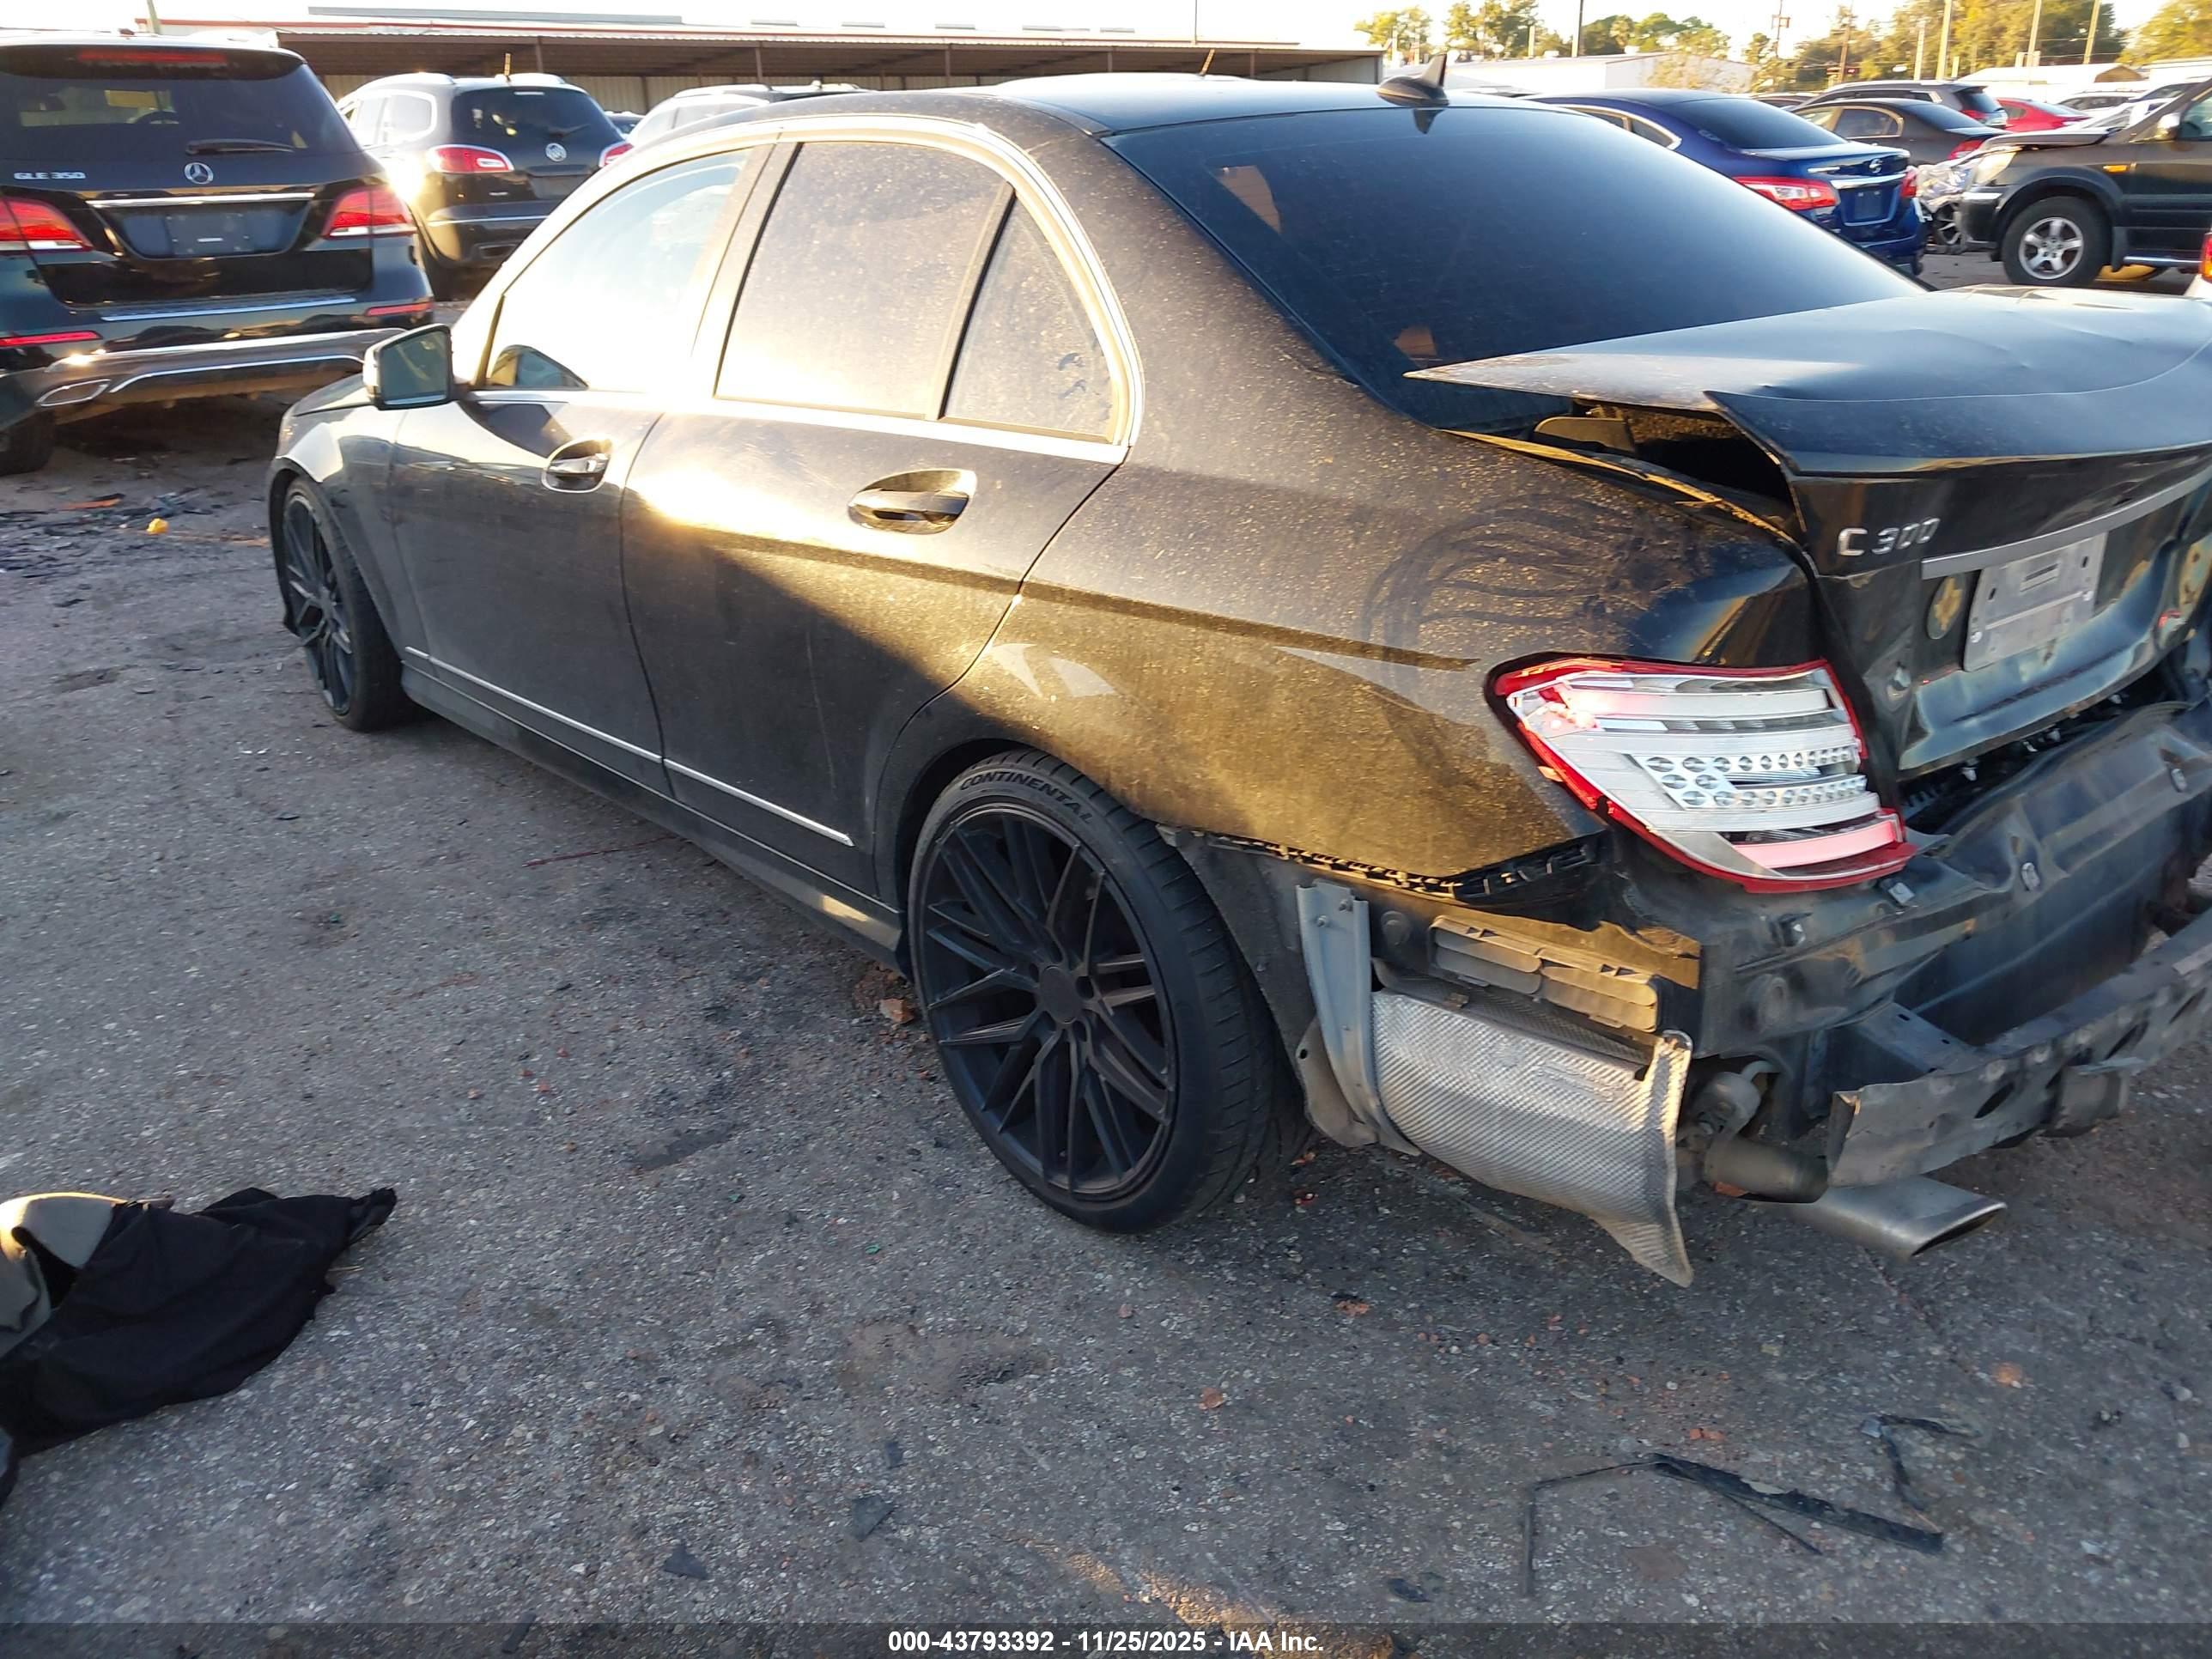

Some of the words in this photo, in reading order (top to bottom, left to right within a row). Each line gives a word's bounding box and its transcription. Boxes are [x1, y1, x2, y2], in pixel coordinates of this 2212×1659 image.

[1838, 527, 1869, 556] C
[1871, 517, 1941, 555] 300
[959, 771, 1093, 824] CONTINENTAL
